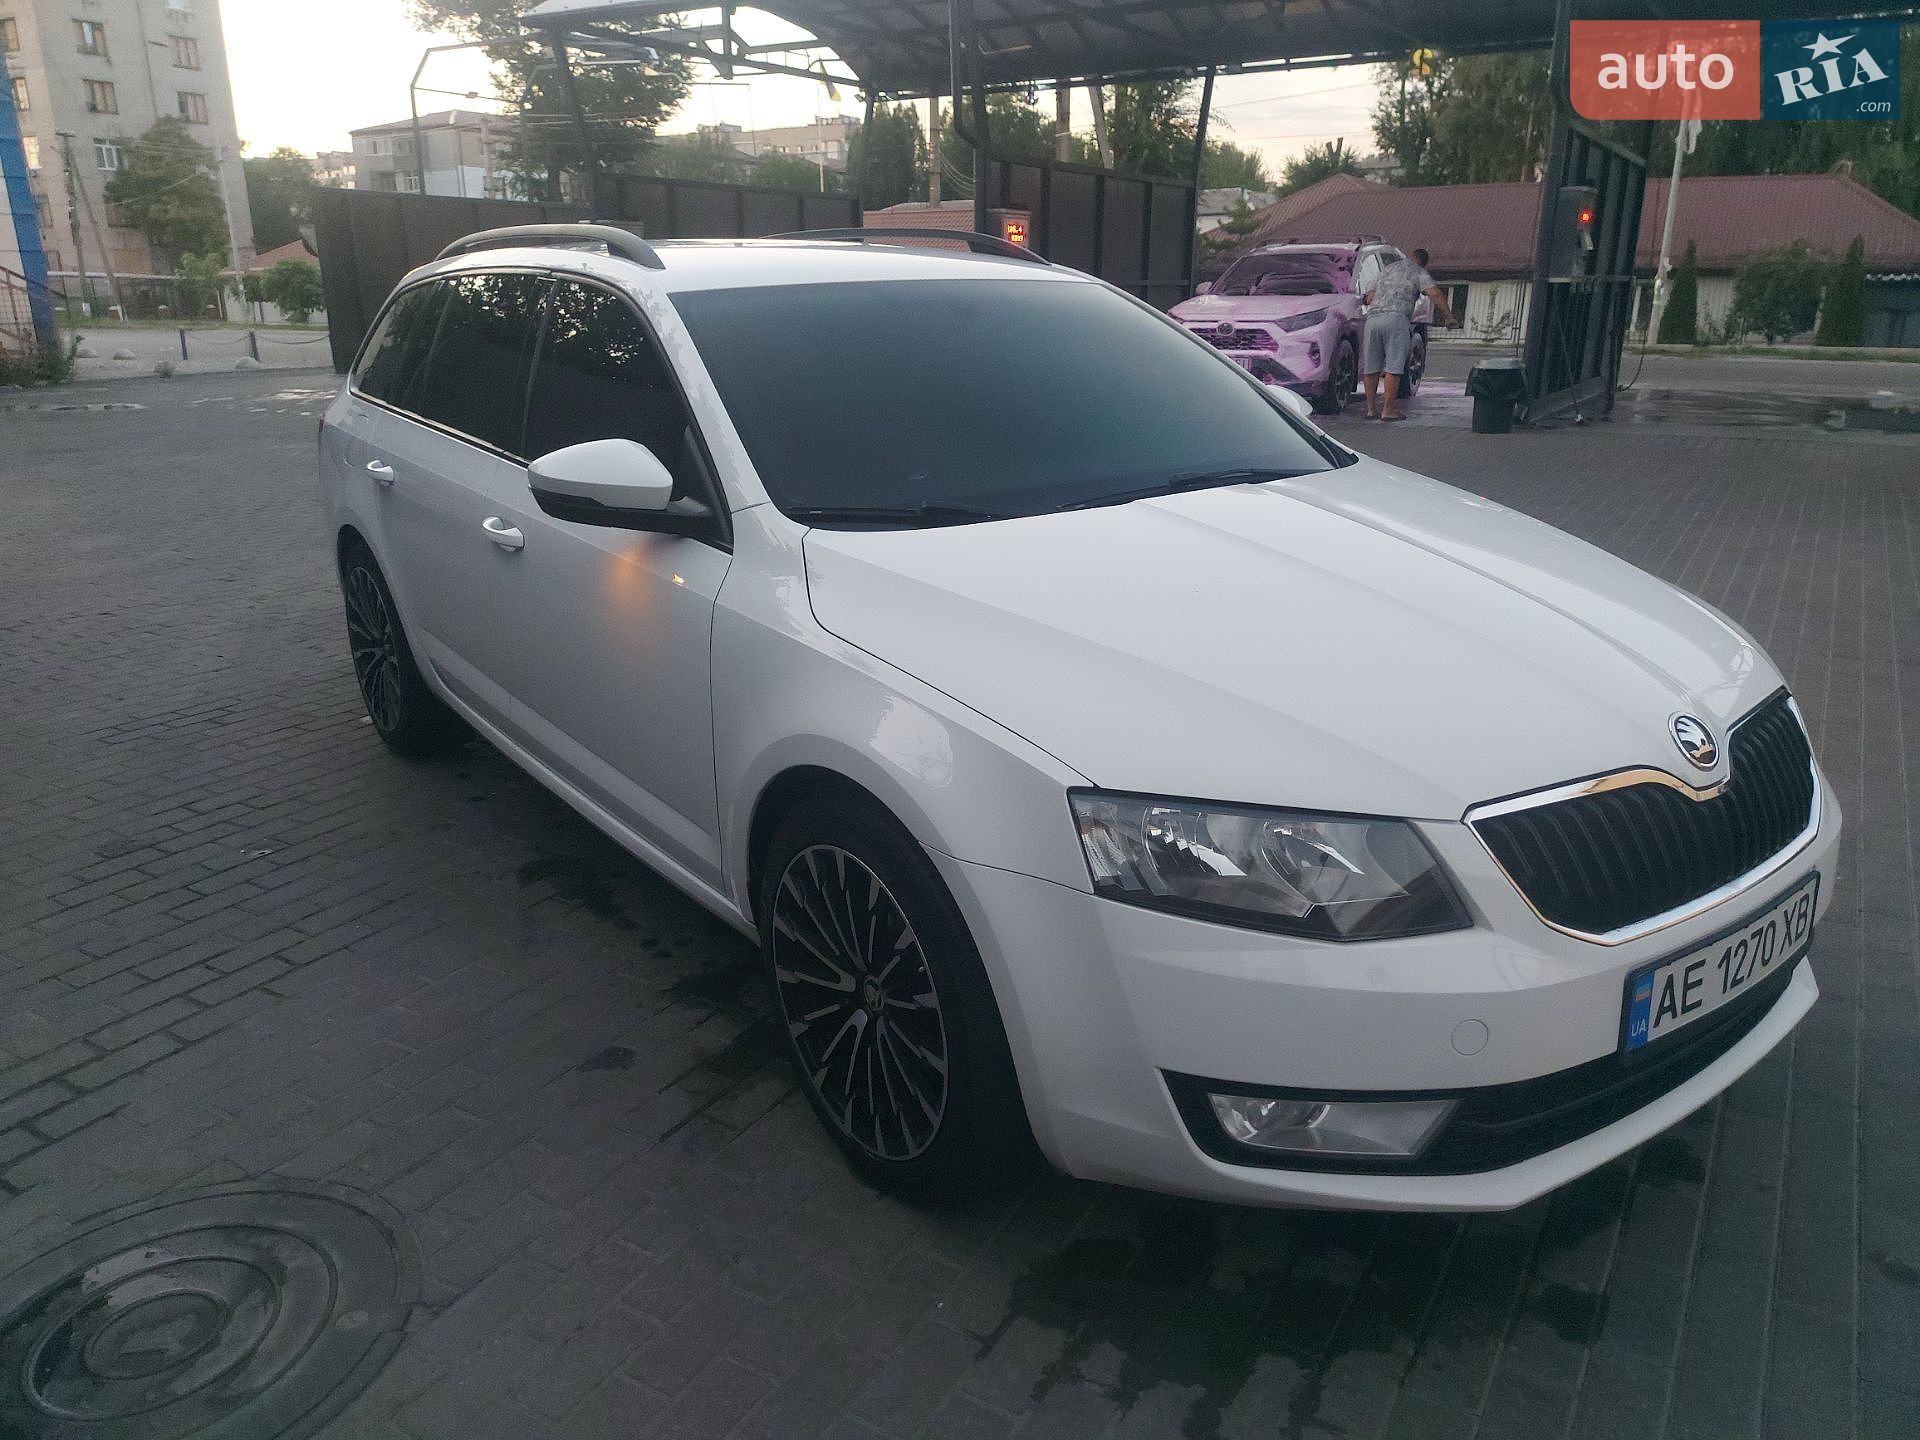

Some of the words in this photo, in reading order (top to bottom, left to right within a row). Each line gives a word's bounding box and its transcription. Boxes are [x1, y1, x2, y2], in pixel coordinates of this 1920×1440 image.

[1653, 959, 1706, 1028] AE
[1718, 920, 1776, 994] 1270
[1779, 893, 1810, 955] XB
[1631, 1020, 1647, 1036] UA
